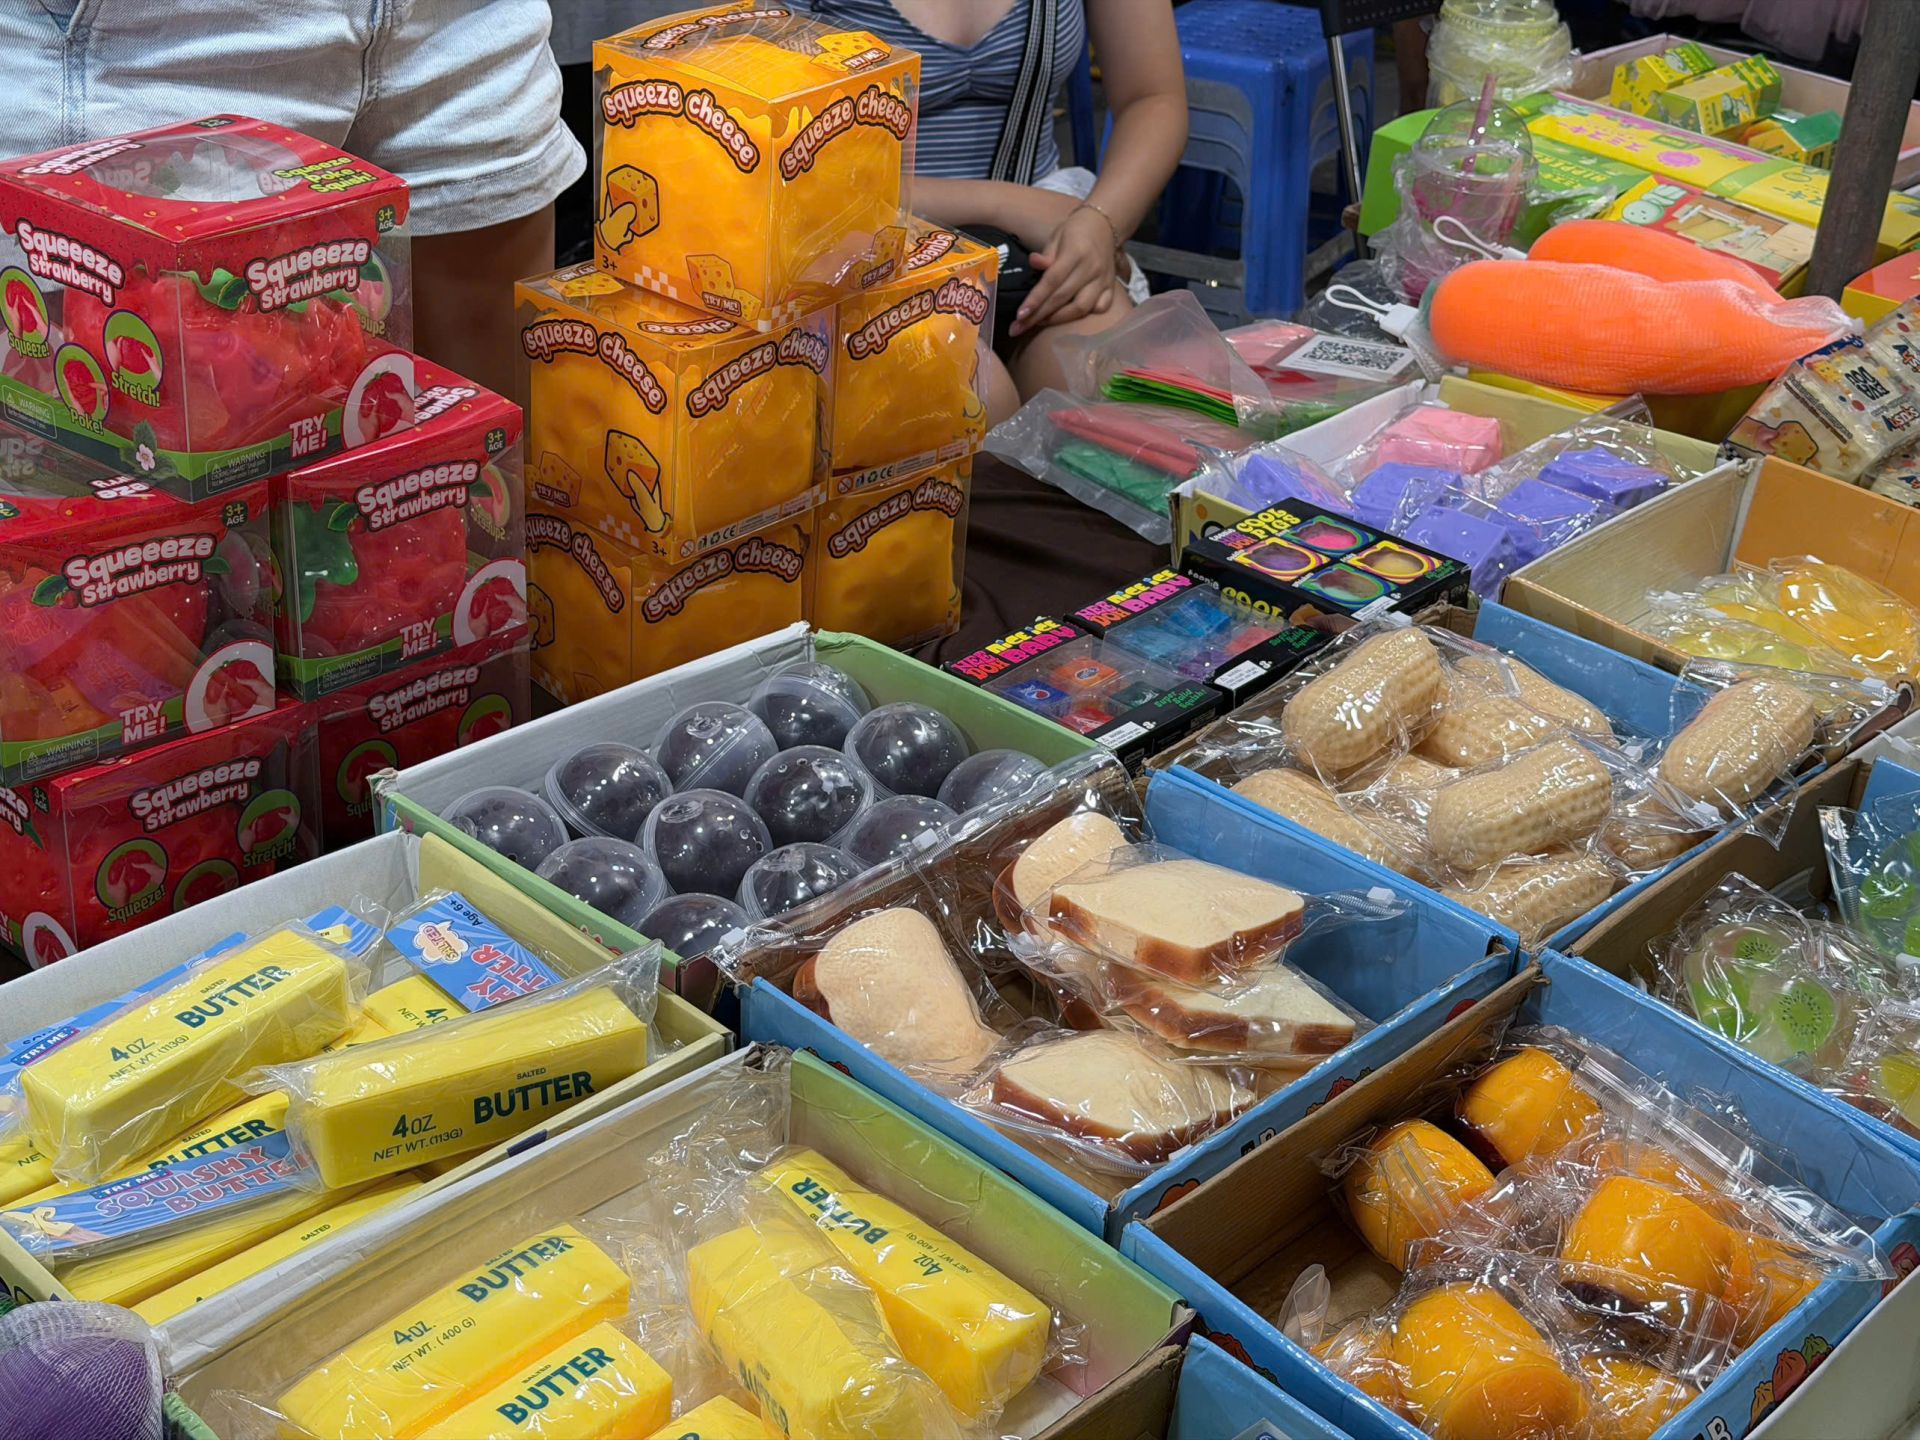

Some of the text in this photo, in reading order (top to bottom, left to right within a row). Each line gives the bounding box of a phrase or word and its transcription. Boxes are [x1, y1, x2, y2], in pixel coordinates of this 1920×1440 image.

[603, 83, 756, 166] squeeze cheese
[782, 89, 911, 174] squeeze cheese
[274, 156, 353, 178] Squeeze
[309, 172, 377, 193] Squish!
[378, 207, 394, 221] 3+
[378, 219, 395, 231] AGE
[601, 254, 618, 272] 3+
[29, 253, 113, 304] Strawberry
[260, 267, 358, 309] Strawberry
[703, 292, 721, 309] TRY
[851, 280, 988, 352] squeeze cheese
[7, 332, 50, 359] Squeeze!
[523, 322, 664, 408] squeeze cheese
[691, 328, 828, 411] squeeze cheese
[111, 371, 161, 407] Stretch!
[70, 408, 105, 437] Poke!
[289, 412, 327, 440] TRY
[486, 429, 503, 443] 3+
[291, 429, 328, 458] ME!
[487, 440, 505, 452] AGE
[225, 503, 245, 517] 3+
[226, 514, 246, 527] AGE
[370, 486, 468, 530] Strawberry
[832, 493, 911, 553] squeeze
[913, 481, 963, 514] cheese
[1236, 507, 1288, 534] COOL
[1250, 514, 1302, 541] PIGS
[525, 516, 570, 548] queeze
[573, 536, 622, 610] cheese
[651, 540, 668, 557] 3+
[82, 560, 200, 604] Strawberry
[647, 540, 800, 615] squeeze cheese
[1122, 574, 1194, 613] BABY
[399, 616, 437, 643] TRY
[402, 631, 438, 660] ME!
[1000, 625, 1078, 665] BABY
[119, 700, 165, 728] TRY
[380, 687, 470, 733] Strawberry
[122, 716, 167, 745] ME!
[145, 782, 249, 831] Strawberry
[243, 836, 298, 868] Stretch!
[108, 884, 167, 924] Squeeze!
[449, 899, 483, 927] Age 6+
[423, 924, 458, 961] SALTED
[471, 943, 548, 994] TTER
[174, 964, 292, 1030] BUTTER
[199, 977, 227, 995] SALTED
[398, 1007, 418, 1022] NET
[22, 1043, 47, 1061] TRY
[48, 1031, 69, 1045] ME
[108, 1063, 137, 1080] NET
[516, 1066, 547, 1080] SALTED
[472, 1070, 596, 1125] BUTTER
[182, 1127, 212, 1144] SALTED
[373, 1144, 403, 1163] NET
[95, 1145, 269, 1218] SQUISHY
[101, 1171, 160, 1196] TRY ME
[790, 1176, 890, 1246] BUTTER
[300, 1223, 331, 1242] SALTED
[456, 1235, 575, 1303] BUTTER
[391, 1352, 416, 1373] NET
[495, 1345, 616, 1426] BUTTER
